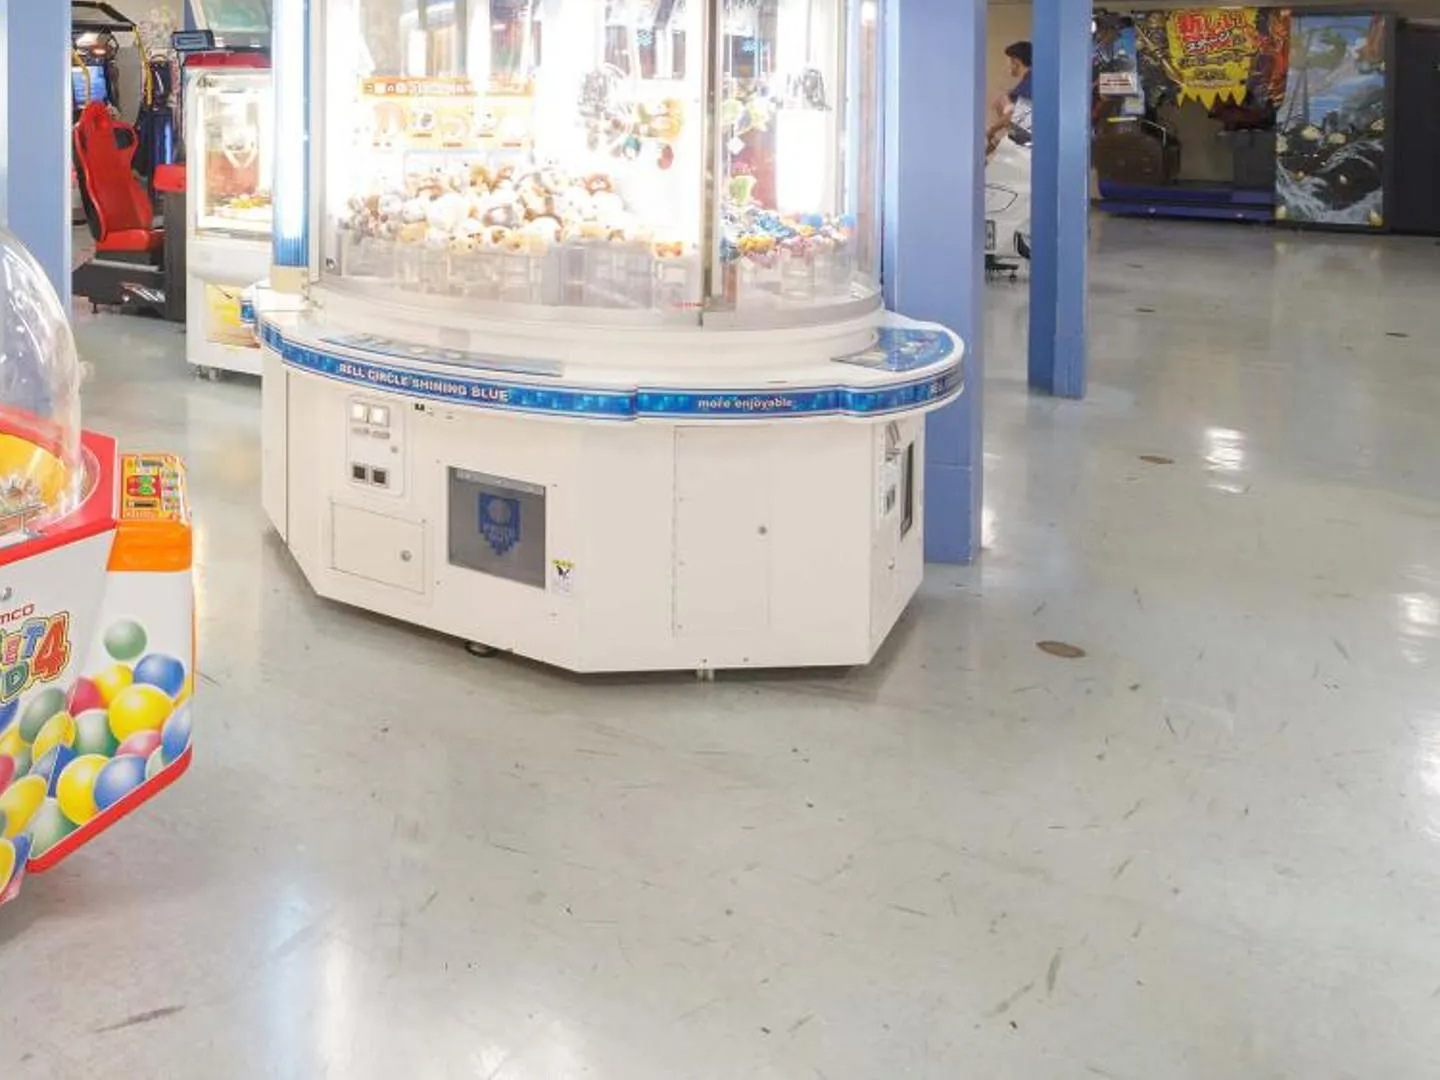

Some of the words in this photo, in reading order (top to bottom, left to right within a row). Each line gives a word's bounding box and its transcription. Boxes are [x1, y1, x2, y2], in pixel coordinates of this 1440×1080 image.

[339, 362, 366, 379] BELL
[367, 369, 408, 385] CIRCLE
[412, 378, 467, 395] SHINING
[471, 386, 510, 402] BLUE
[698, 399, 731, 408] more
[734, 397, 793, 410] enjoyable
[31, 611, 71, 683] 4
